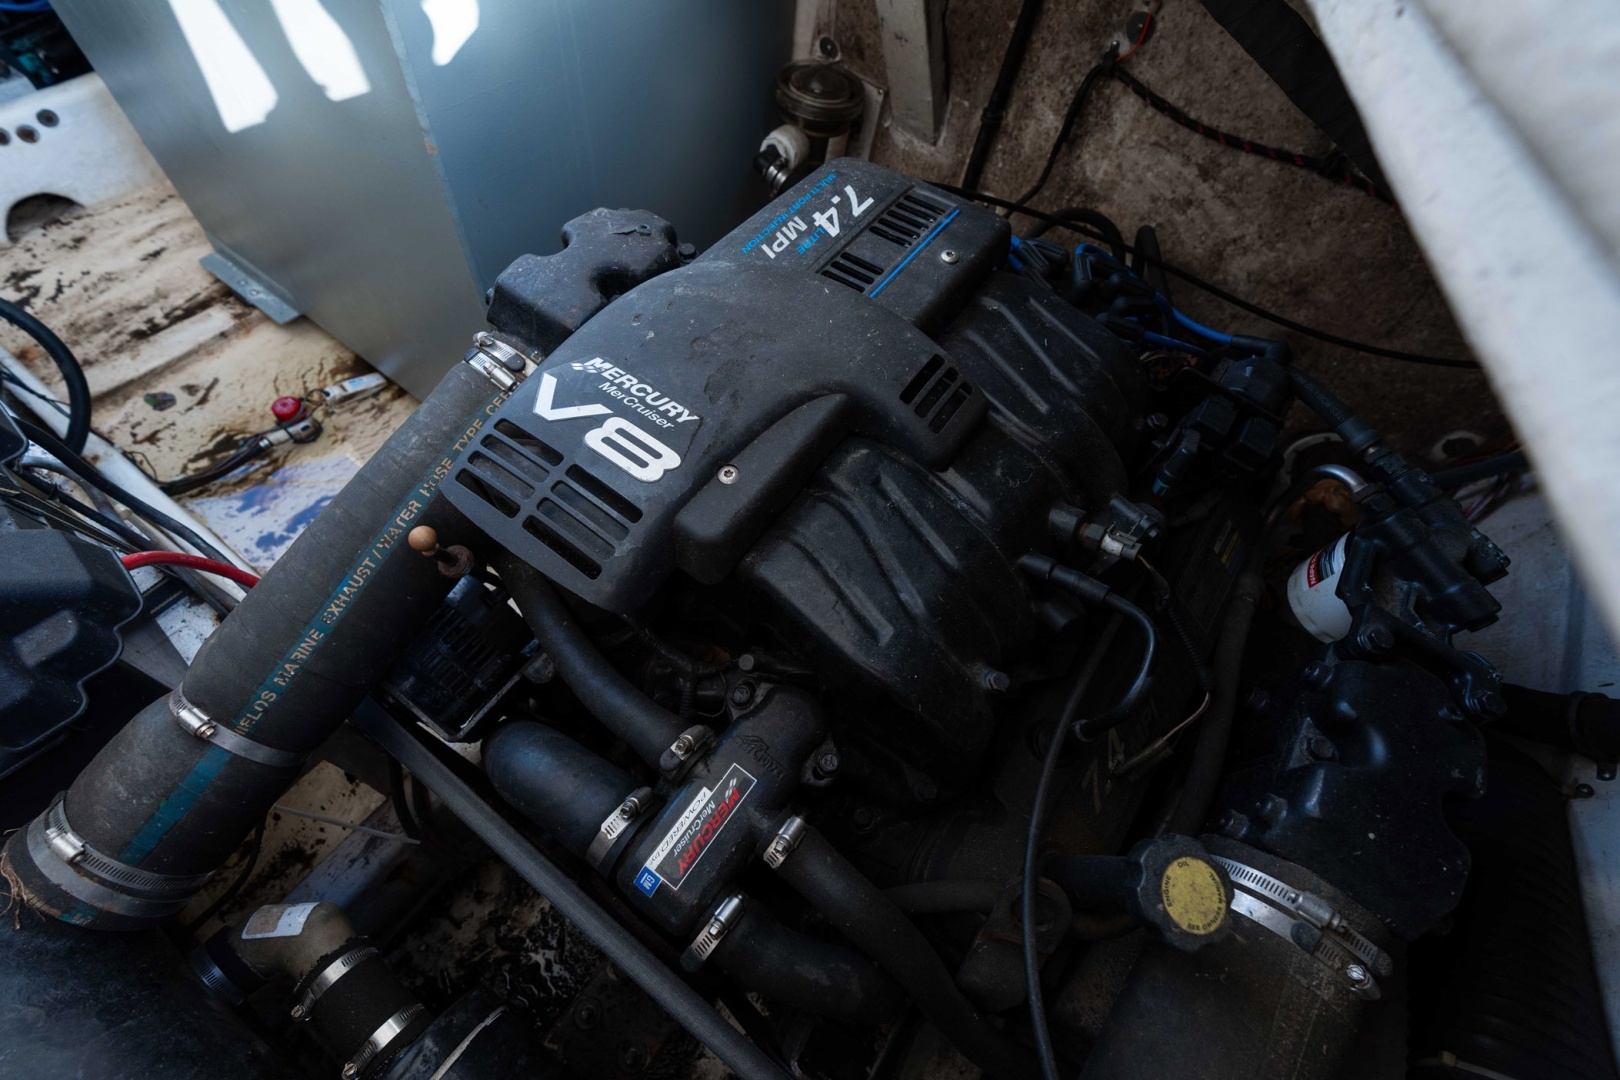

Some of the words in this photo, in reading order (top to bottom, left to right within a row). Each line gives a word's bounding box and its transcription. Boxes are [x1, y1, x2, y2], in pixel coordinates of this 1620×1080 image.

[788, 192, 812, 214] PORT
[810, 172, 837, 195] MULTI
[741, 212, 788, 254] INJECTION
[812, 185, 875, 238] 7.4
[761, 216, 808, 259] MPI
[795, 227, 826, 255] LITRE
[584, 357, 699, 423] MERCURY
[598, 381, 675, 430] MerCruiser
[534, 372, 682, 482] V8
[273, 628, 325, 686] MARINE
[320, 556, 376, 624] EXHAUST
[376, 500, 422, 549] WATER
[419, 458, 452, 497] HOSE
[453, 419, 484, 452] TYPE
[661, 792, 707, 852] POWERED
[673, 800, 716, 857] MerCruiser
[678, 787, 741, 875] MERCURY
[642, 875, 656, 890] GM
